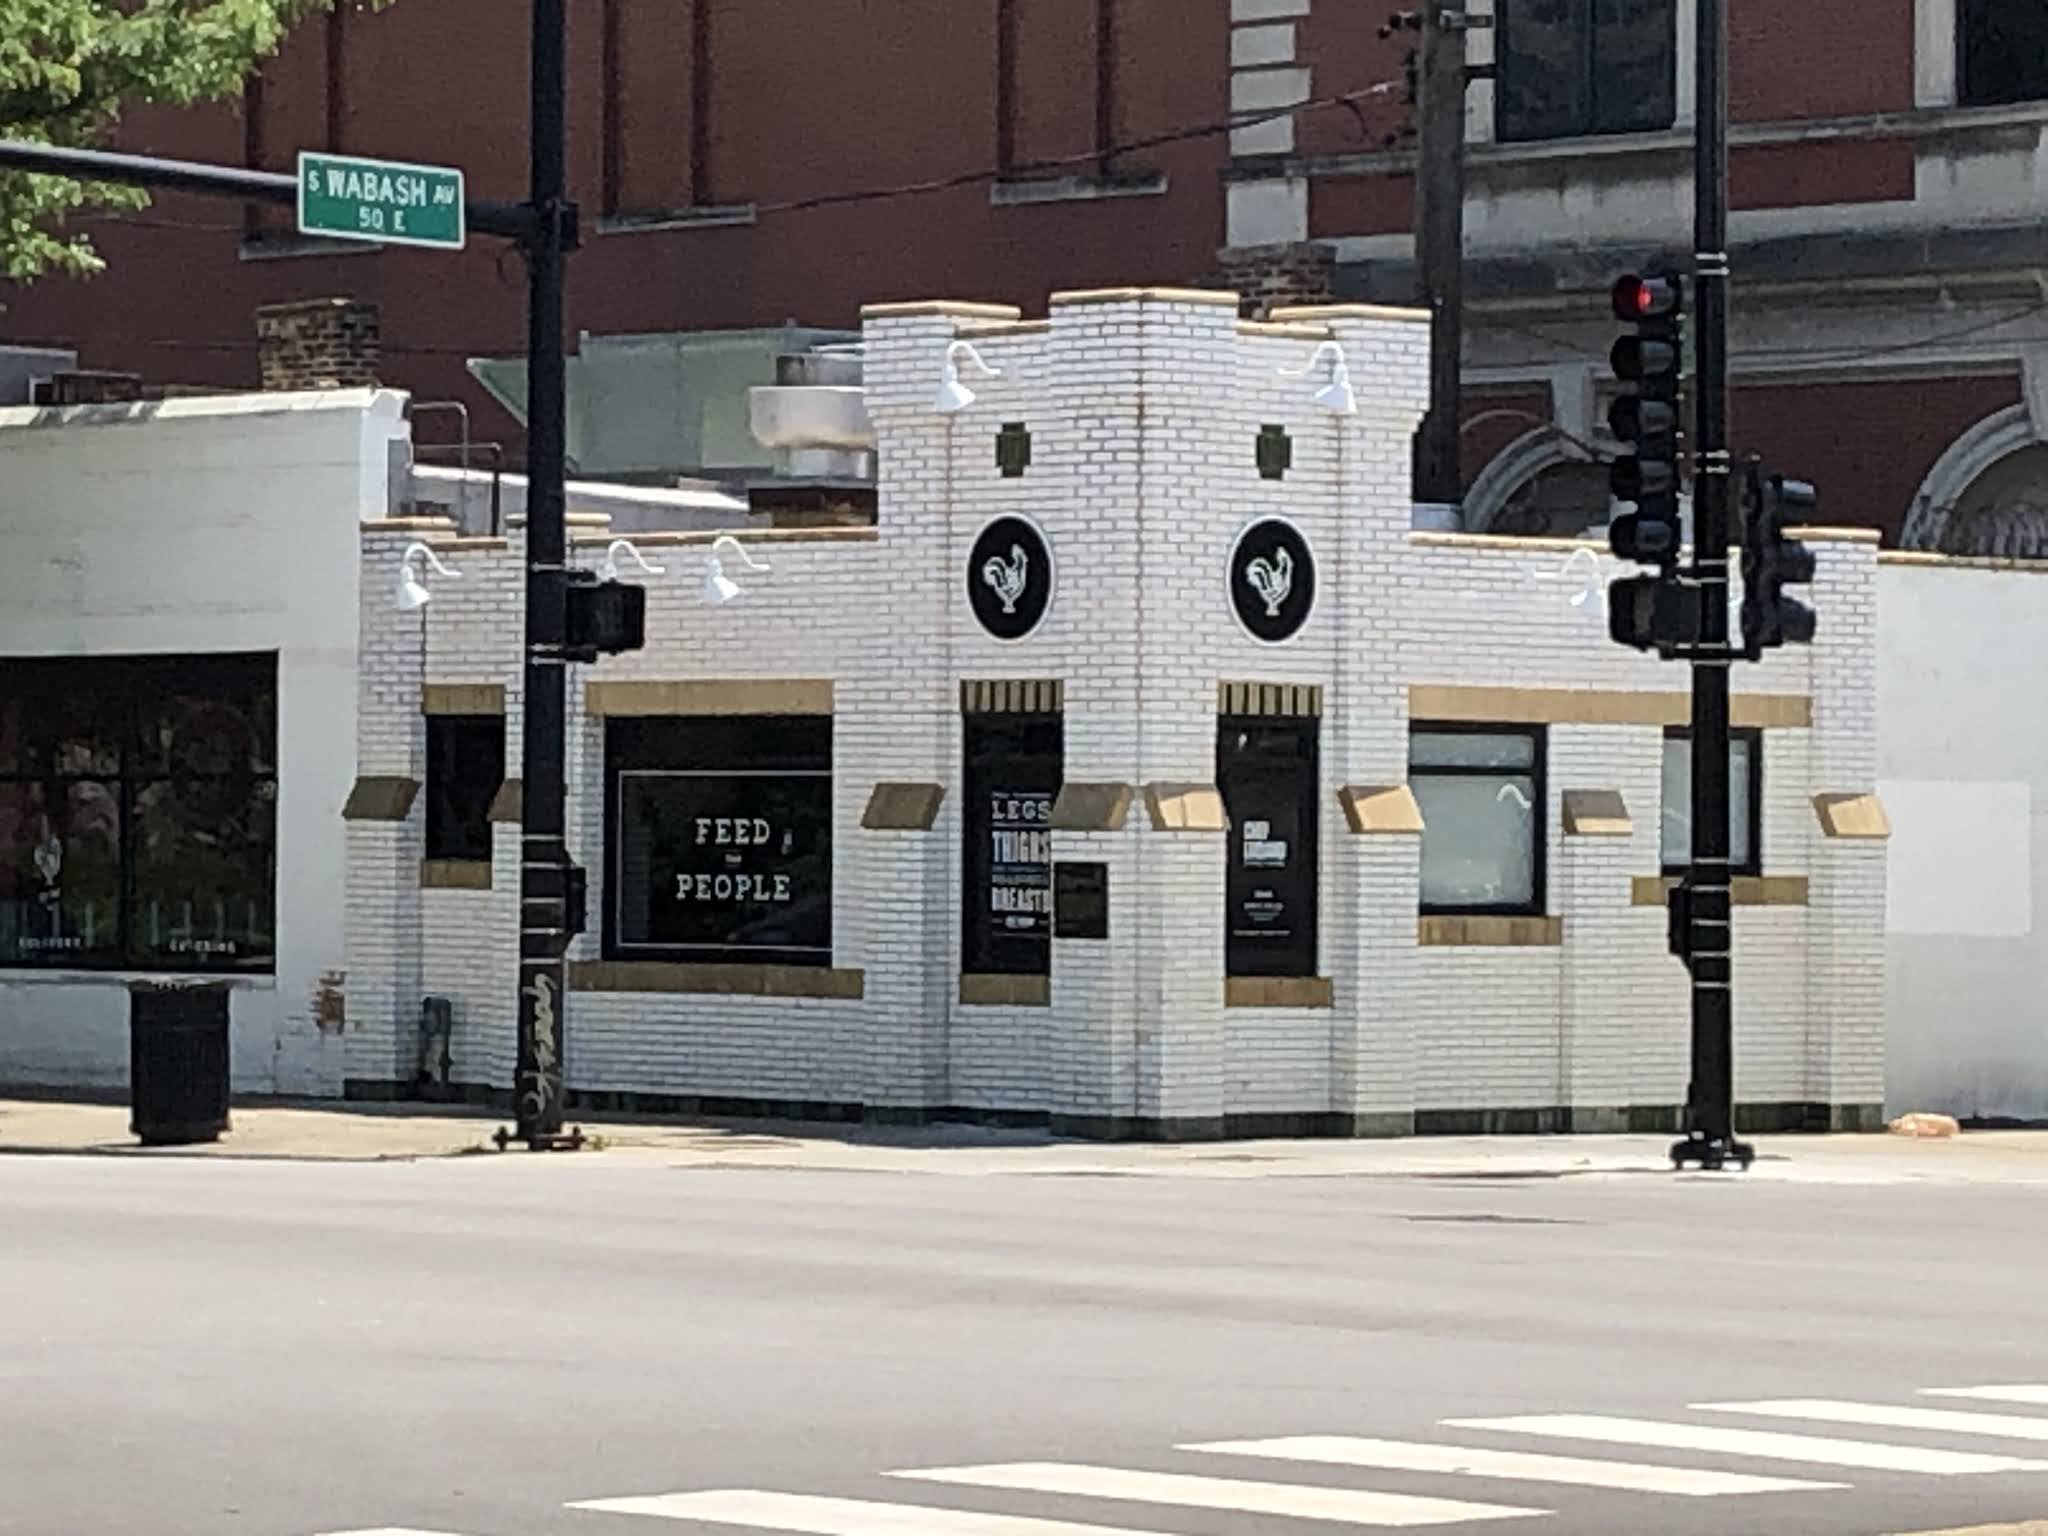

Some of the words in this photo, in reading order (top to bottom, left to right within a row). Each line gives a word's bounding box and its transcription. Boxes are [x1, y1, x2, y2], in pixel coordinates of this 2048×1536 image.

[309, 169, 320, 192] S
[326, 169, 427, 207] WABASH
[433, 185, 455, 205] AV
[359, 206, 384, 229] 50
[394, 210, 406, 232] E
[992, 800, 1052, 820] LEGS
[695, 818, 770, 845] FEED
[675, 873, 791, 901] PEOPLE
